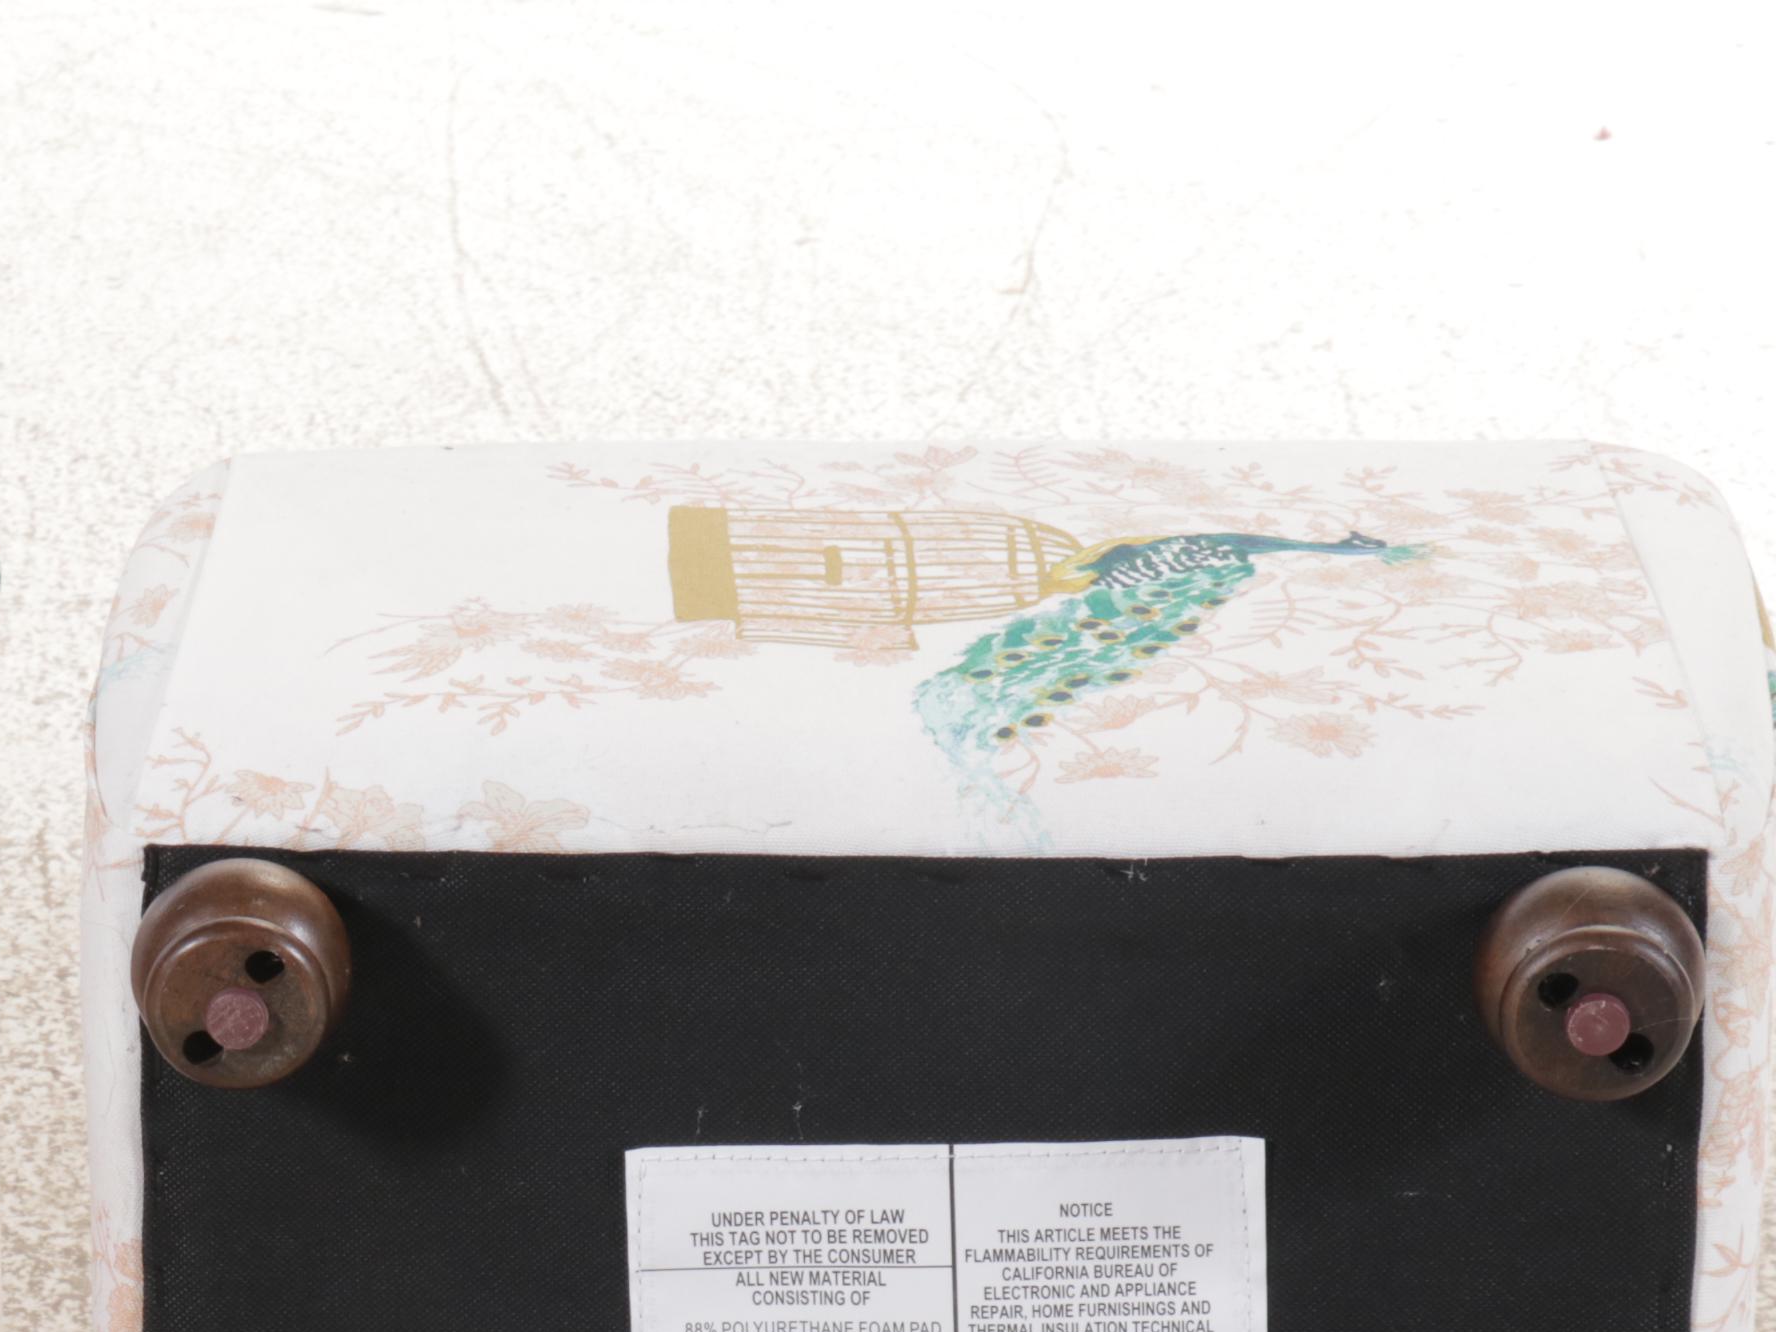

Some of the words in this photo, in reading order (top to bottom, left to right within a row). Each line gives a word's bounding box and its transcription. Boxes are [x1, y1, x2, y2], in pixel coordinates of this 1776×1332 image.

[712, 1211, 765, 1227] UNDER
[770, 1210, 840, 1226] PENALTY
[845, 1209, 865, 1225] OF
[870, 1209, 904, 1224] LAW
[1060, 1202, 1113, 1218] NOTICE
[690, 1232, 724, 1247] THIS
[728, 1231, 760, 1246] TAG
[765, 1230, 796, 1245] NOT
[801, 1229, 822, 1244] TO
[827, 1229, 847, 1244] BE
[852, 1229, 929, 1244] REMOVED
[998, 1229, 1030, 1243] THIS
[1034, 1228, 1095, 1243] ARTICLE
[1100, 1226, 1149, 1241] MEETS
[1153, 1225, 1181, 1240] THE
[703, 1250, 763, 1266] EXCEPT
[768, 1249, 788, 1264] BY
[793, 1249, 822, 1264] THE
[828, 1248, 916, 1264] CONSUMER
[965, 1247, 1071, 1263] FLAMMABILITY
[1076, 1244, 1190, 1260] REQUIREMENTS
[1194, 1243, 1213, 1258] OF
[736, 1272, 764, 1287] ALL
[769, 1271, 804, 1286] NEW
[809, 1270, 886, 1286] MATERIAL
[1002, 1265, 1089, 1281] CALIFORNIA
[1094, 1263, 1154, 1279] BUREAU
[1159, 1262, 1177, 1277] OF
[752, 1290, 845, 1306] CONSISTING
[850, 1290, 870, 1306] OF
[984, 1284, 1075, 1301] ELECTRONIC
[1080, 1283, 1110, 1298] AND
[1115, 1281, 1196, 1297] APPLIANCE
[971, 1305, 1027, 1320] REPAIR,
[1032, 1303, 1074, 1318] HOME
[1078, 1301, 1176, 1317] FURNISHINGS
[1181, 1300, 1211, 1315] AND
